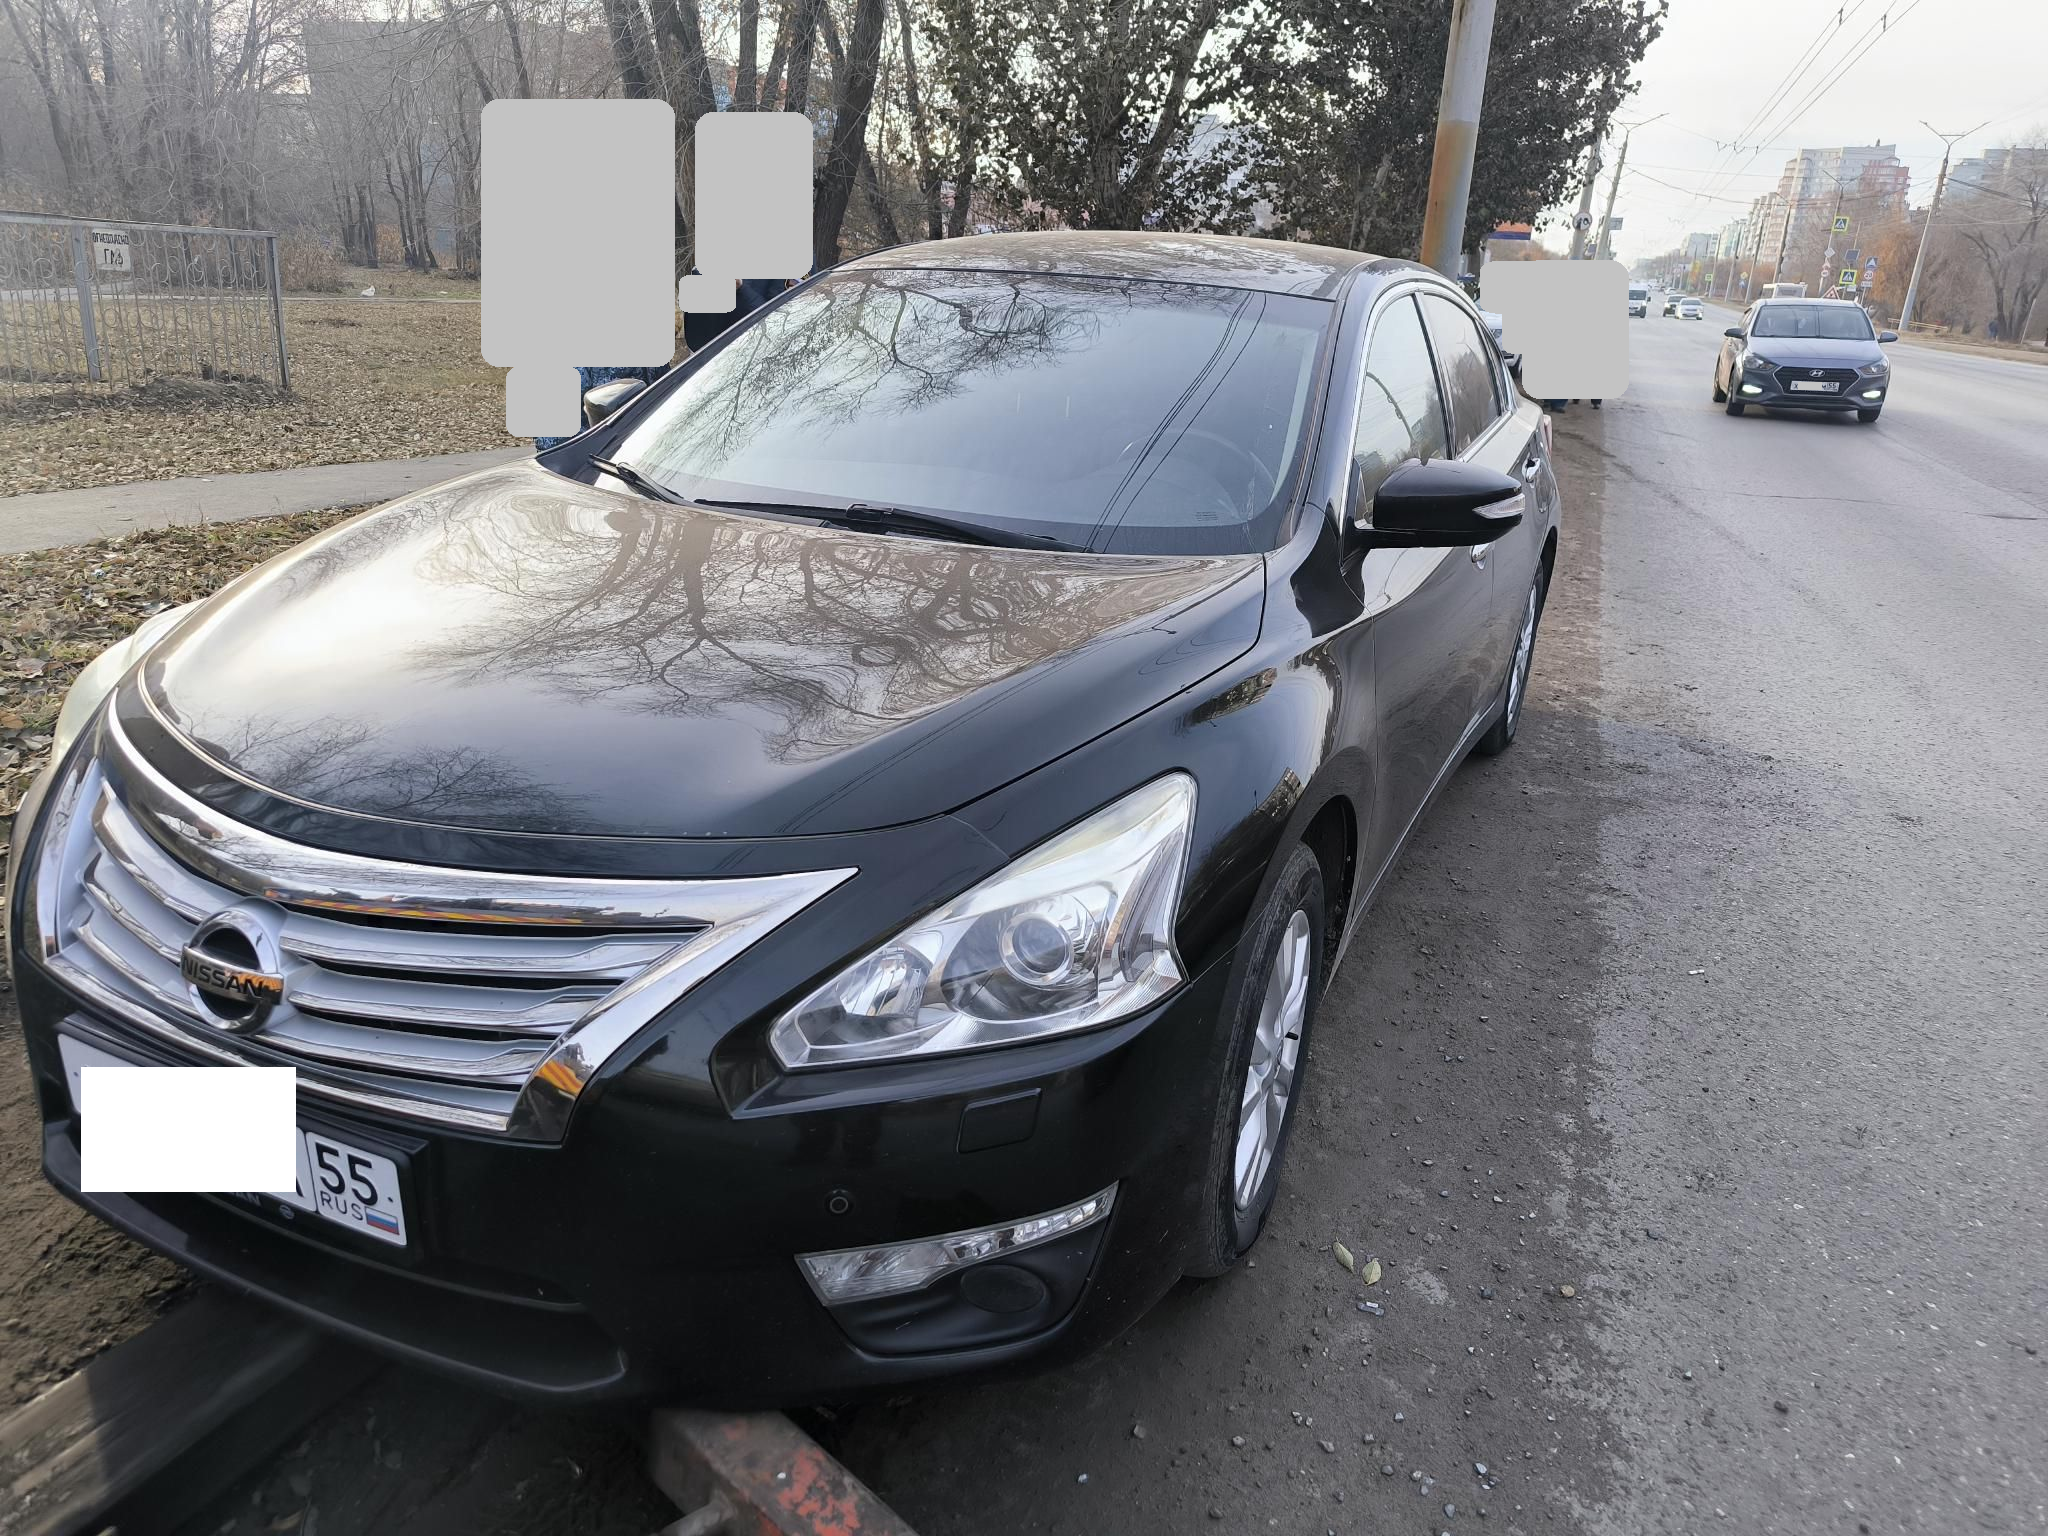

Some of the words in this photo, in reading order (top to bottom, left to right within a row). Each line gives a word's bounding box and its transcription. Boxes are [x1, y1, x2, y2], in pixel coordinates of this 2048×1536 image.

[183, 956, 264, 999] NISSAN
[315, 1142, 378, 1206] 55
[320, 1191, 363, 1221] RUS
